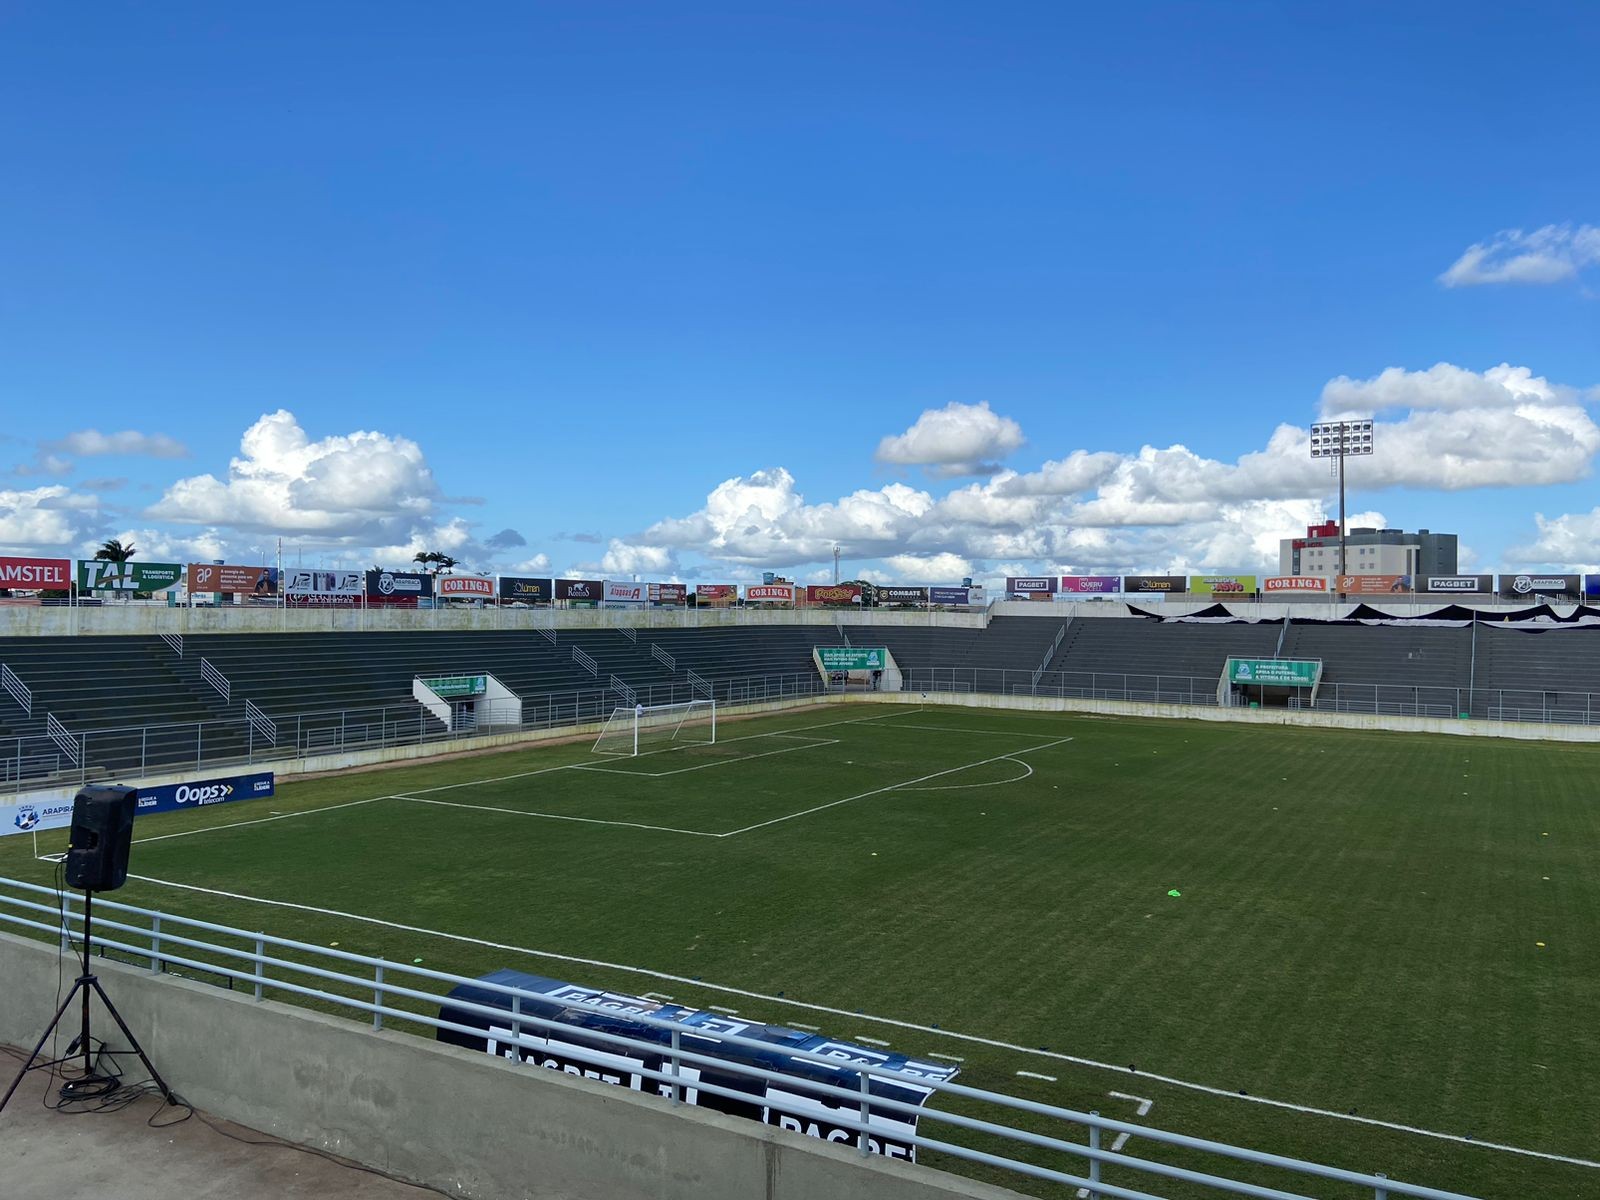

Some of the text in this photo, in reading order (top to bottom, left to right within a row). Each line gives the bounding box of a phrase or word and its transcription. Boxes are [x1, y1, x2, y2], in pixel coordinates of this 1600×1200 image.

[84, 562, 140, 589] TAL
[444, 580, 490, 592] CORINGA
[1268, 579, 1322, 589] CORINGA
[750, 588, 789, 597] CORINGA
[175, 785, 219, 805] Oops
